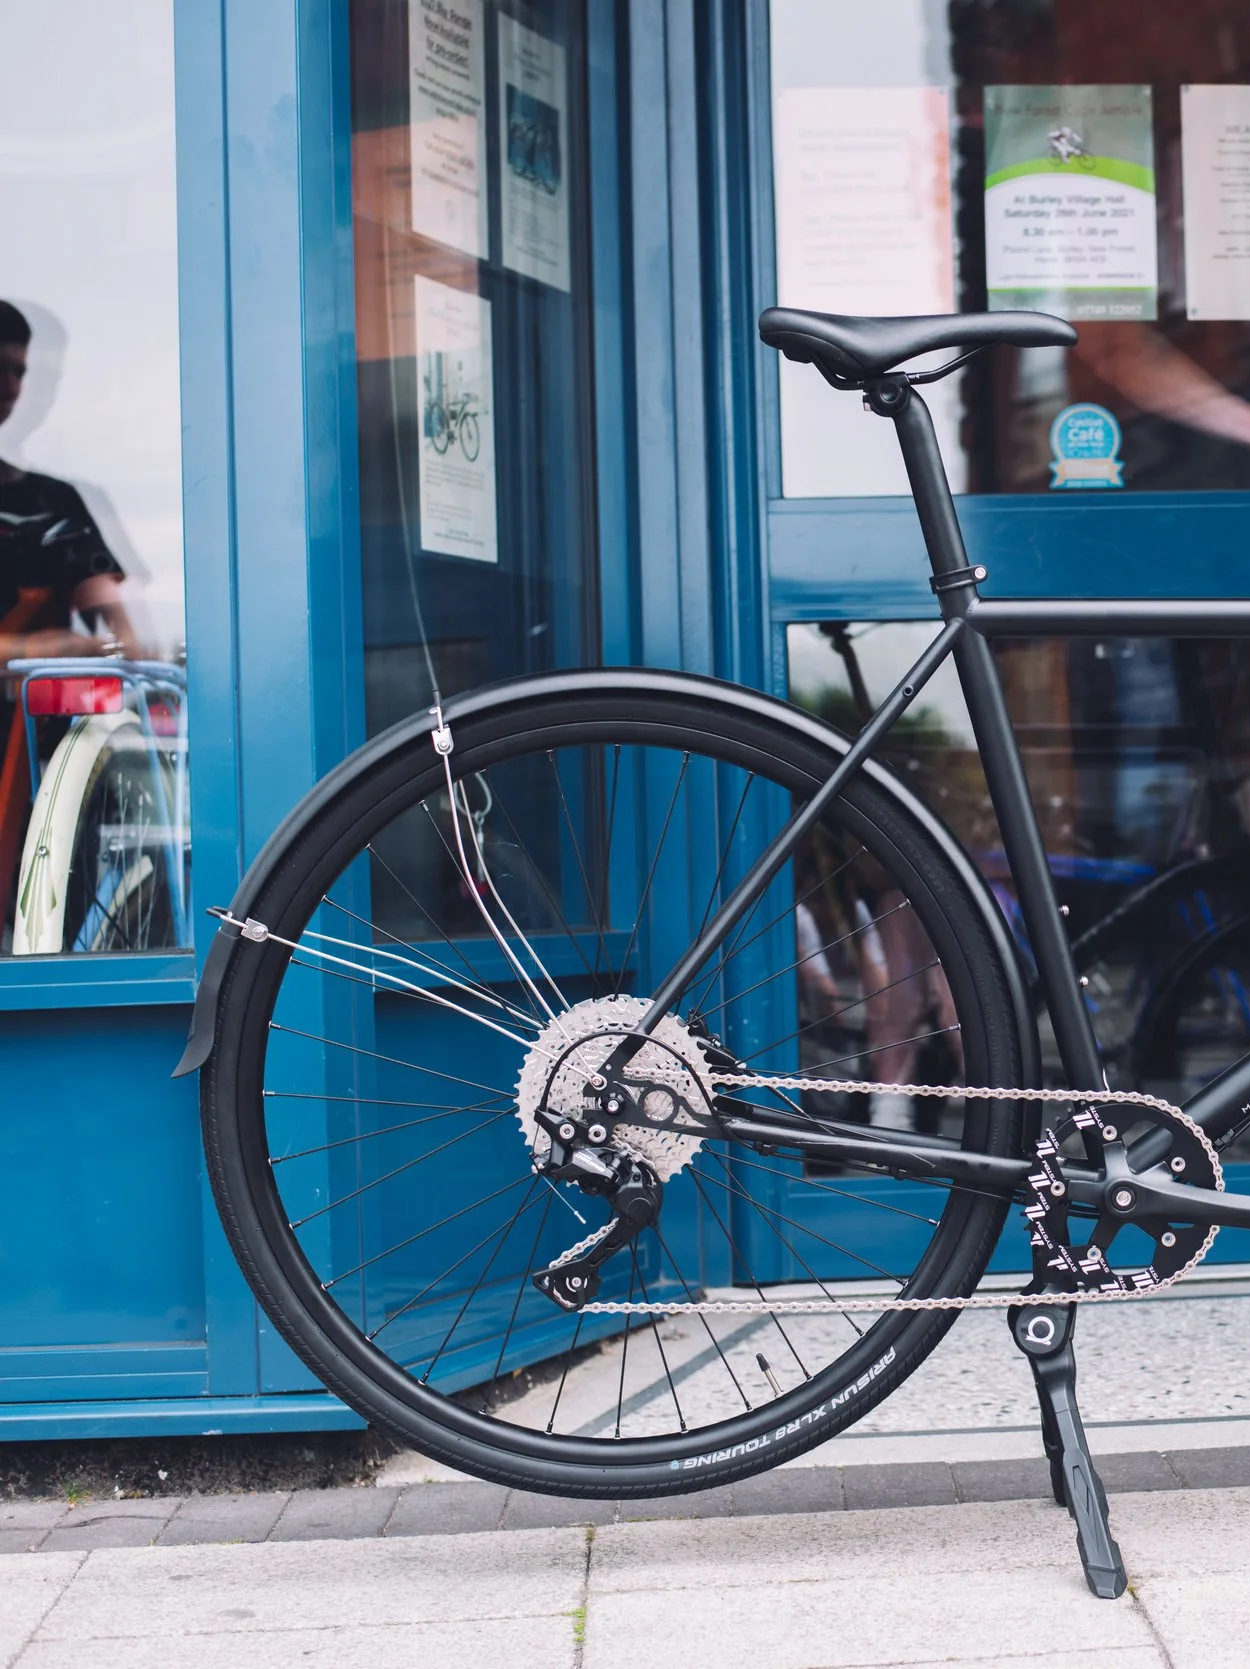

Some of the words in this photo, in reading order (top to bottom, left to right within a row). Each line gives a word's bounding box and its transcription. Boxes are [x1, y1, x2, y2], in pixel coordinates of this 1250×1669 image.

[1004, 209, 1051, 219] Saturday
[1082, 208, 1107, 218] June
[1111, 208, 1135, 218] 2021
[1067, 195, 1101, 207] Village
[1067, 427, 1105, 442] Café
[1036, 1221, 1053, 1250] SYSTEM
[1058, 1244, 1078, 1273] SYSTEM
[832, 1345, 897, 1409] ARISUN
[683, 1434, 772, 1470] TOURING
